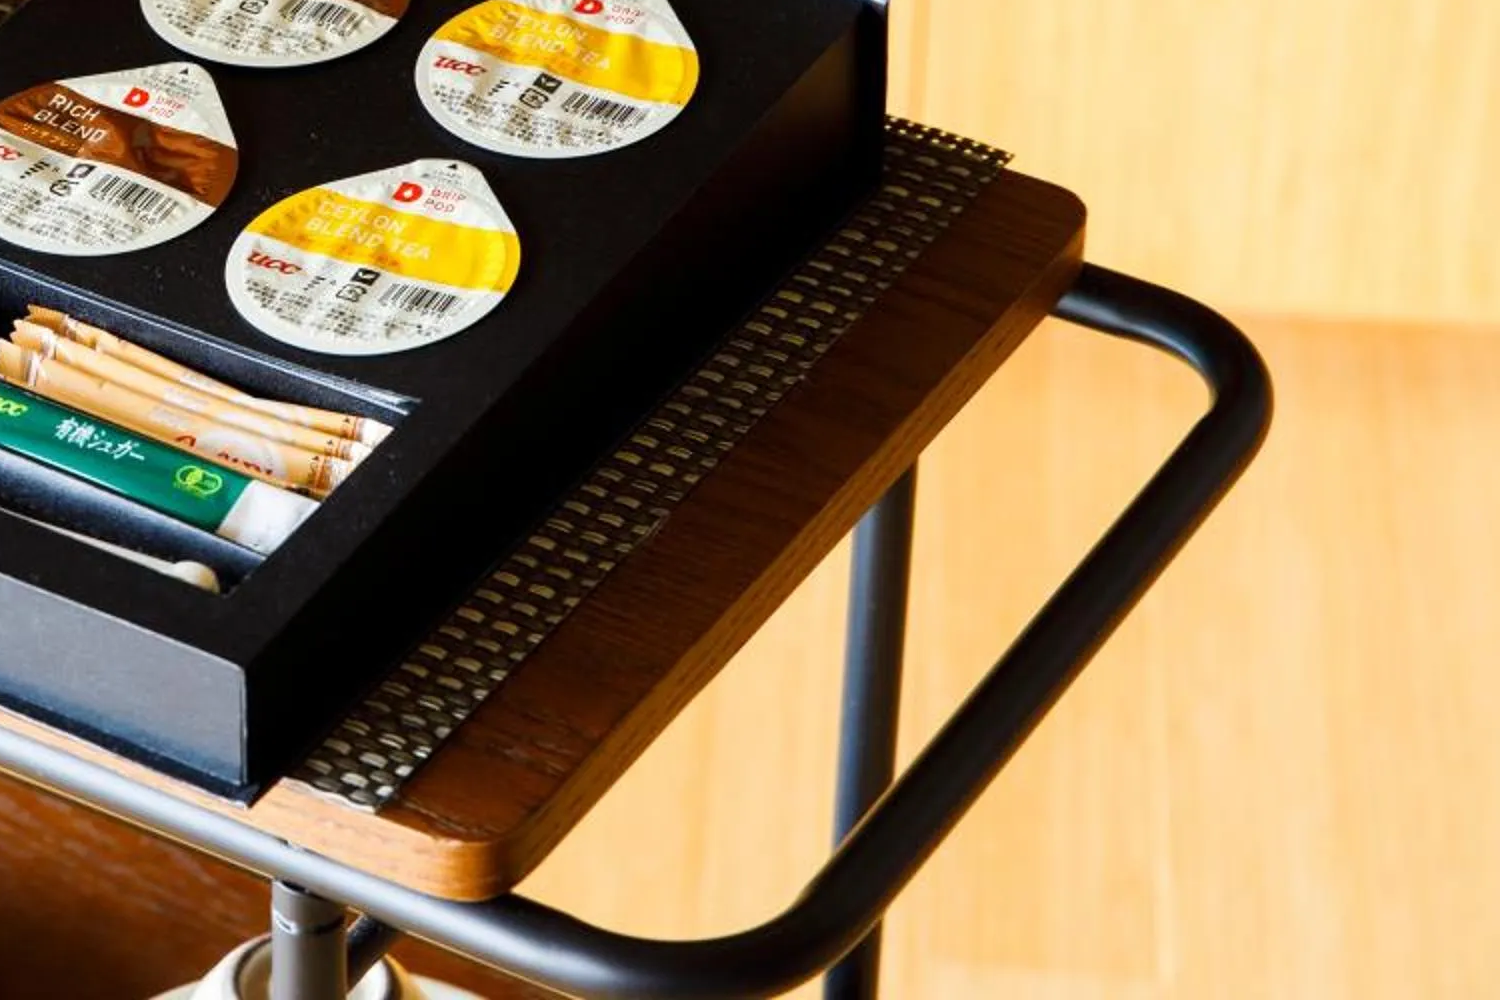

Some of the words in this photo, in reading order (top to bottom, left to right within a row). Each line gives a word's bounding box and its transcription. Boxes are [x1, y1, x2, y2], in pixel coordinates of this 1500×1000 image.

[490, 24, 565, 54] BLEND
[573, 47, 611, 70] TEA
[32, 109, 109, 144] BLEND
[47, 93, 101, 121] RICH
[317, 200, 407, 235] CEYLON
[305, 216, 385, 249] BLEND
[388, 238, 432, 261] TEA
[55, 416, 146, 462] 有機シュガー
